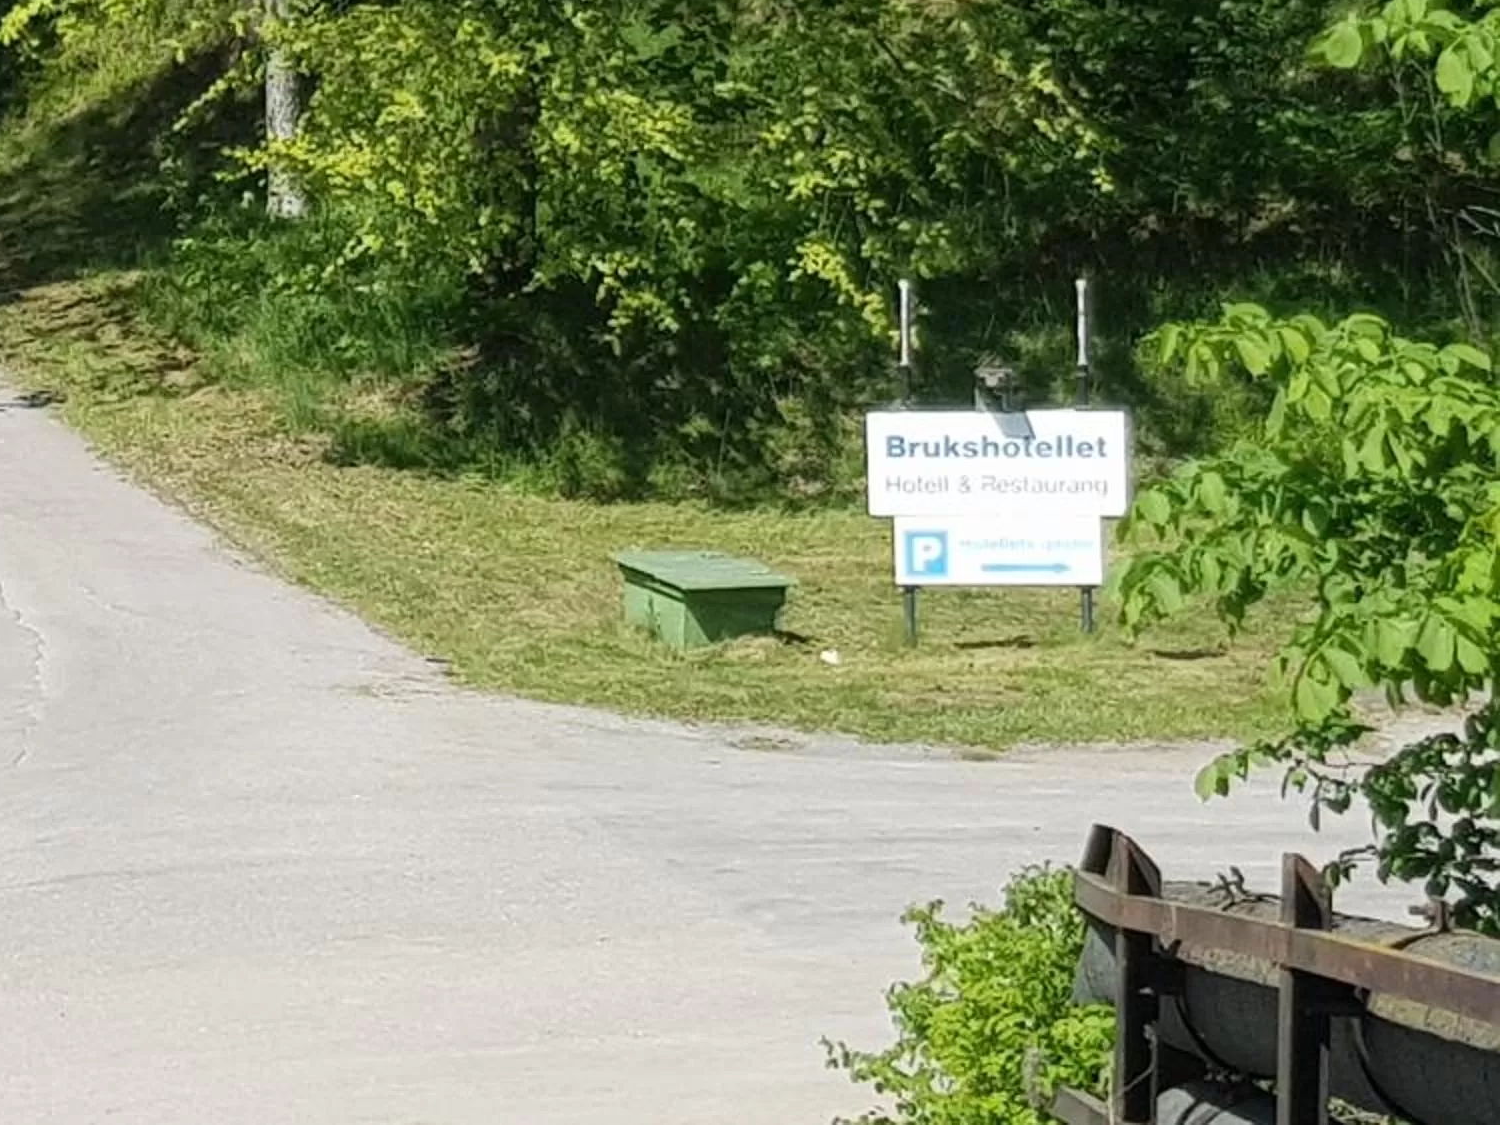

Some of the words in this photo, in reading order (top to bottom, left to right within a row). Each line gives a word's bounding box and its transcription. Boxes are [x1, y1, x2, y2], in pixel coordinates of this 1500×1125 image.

[885, 434, 1108, 458] Brukshotellet
[885, 475, 949, 494] Hotell
[958, 475, 972, 494] &
[980, 475, 1108, 498] Restaurang
[912, 535, 942, 573] P
